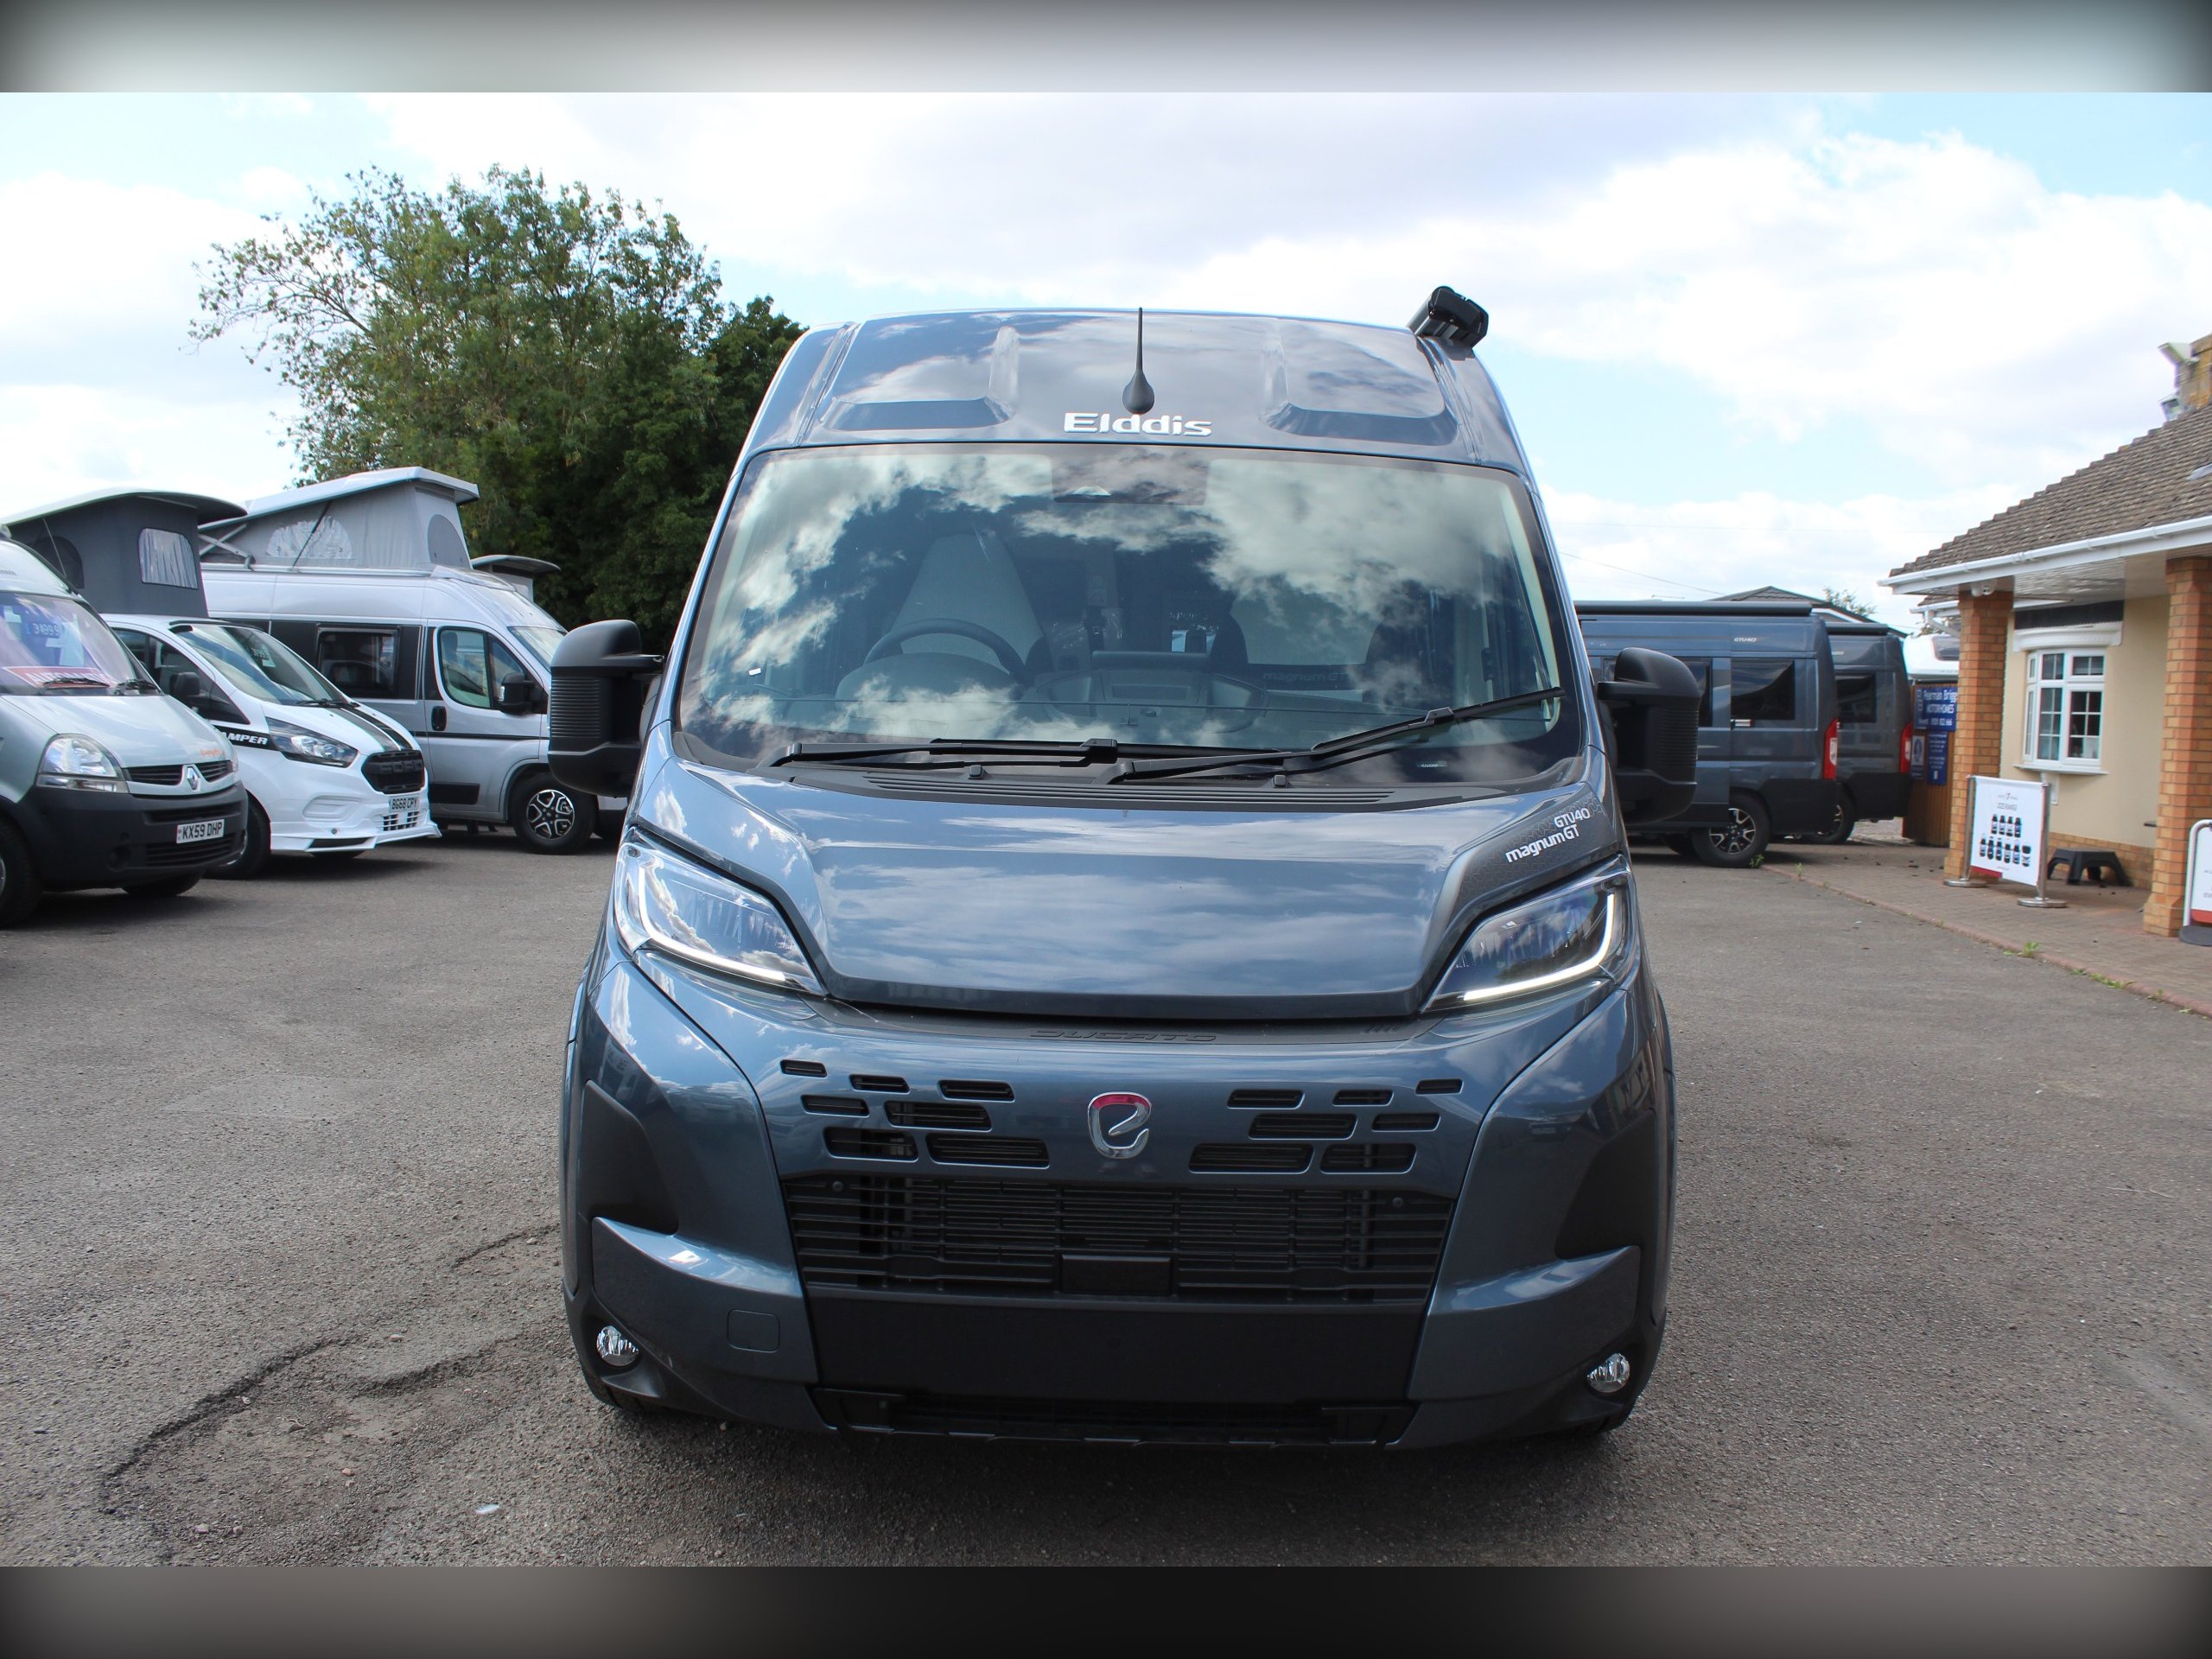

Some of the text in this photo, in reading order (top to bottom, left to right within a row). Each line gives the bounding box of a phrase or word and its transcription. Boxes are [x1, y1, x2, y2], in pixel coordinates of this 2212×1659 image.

[1064, 412, 1211, 437] Elddis
[182, 822, 222, 840] KX59 DHP
[1030, 1031, 1217, 1042] DUCATO
